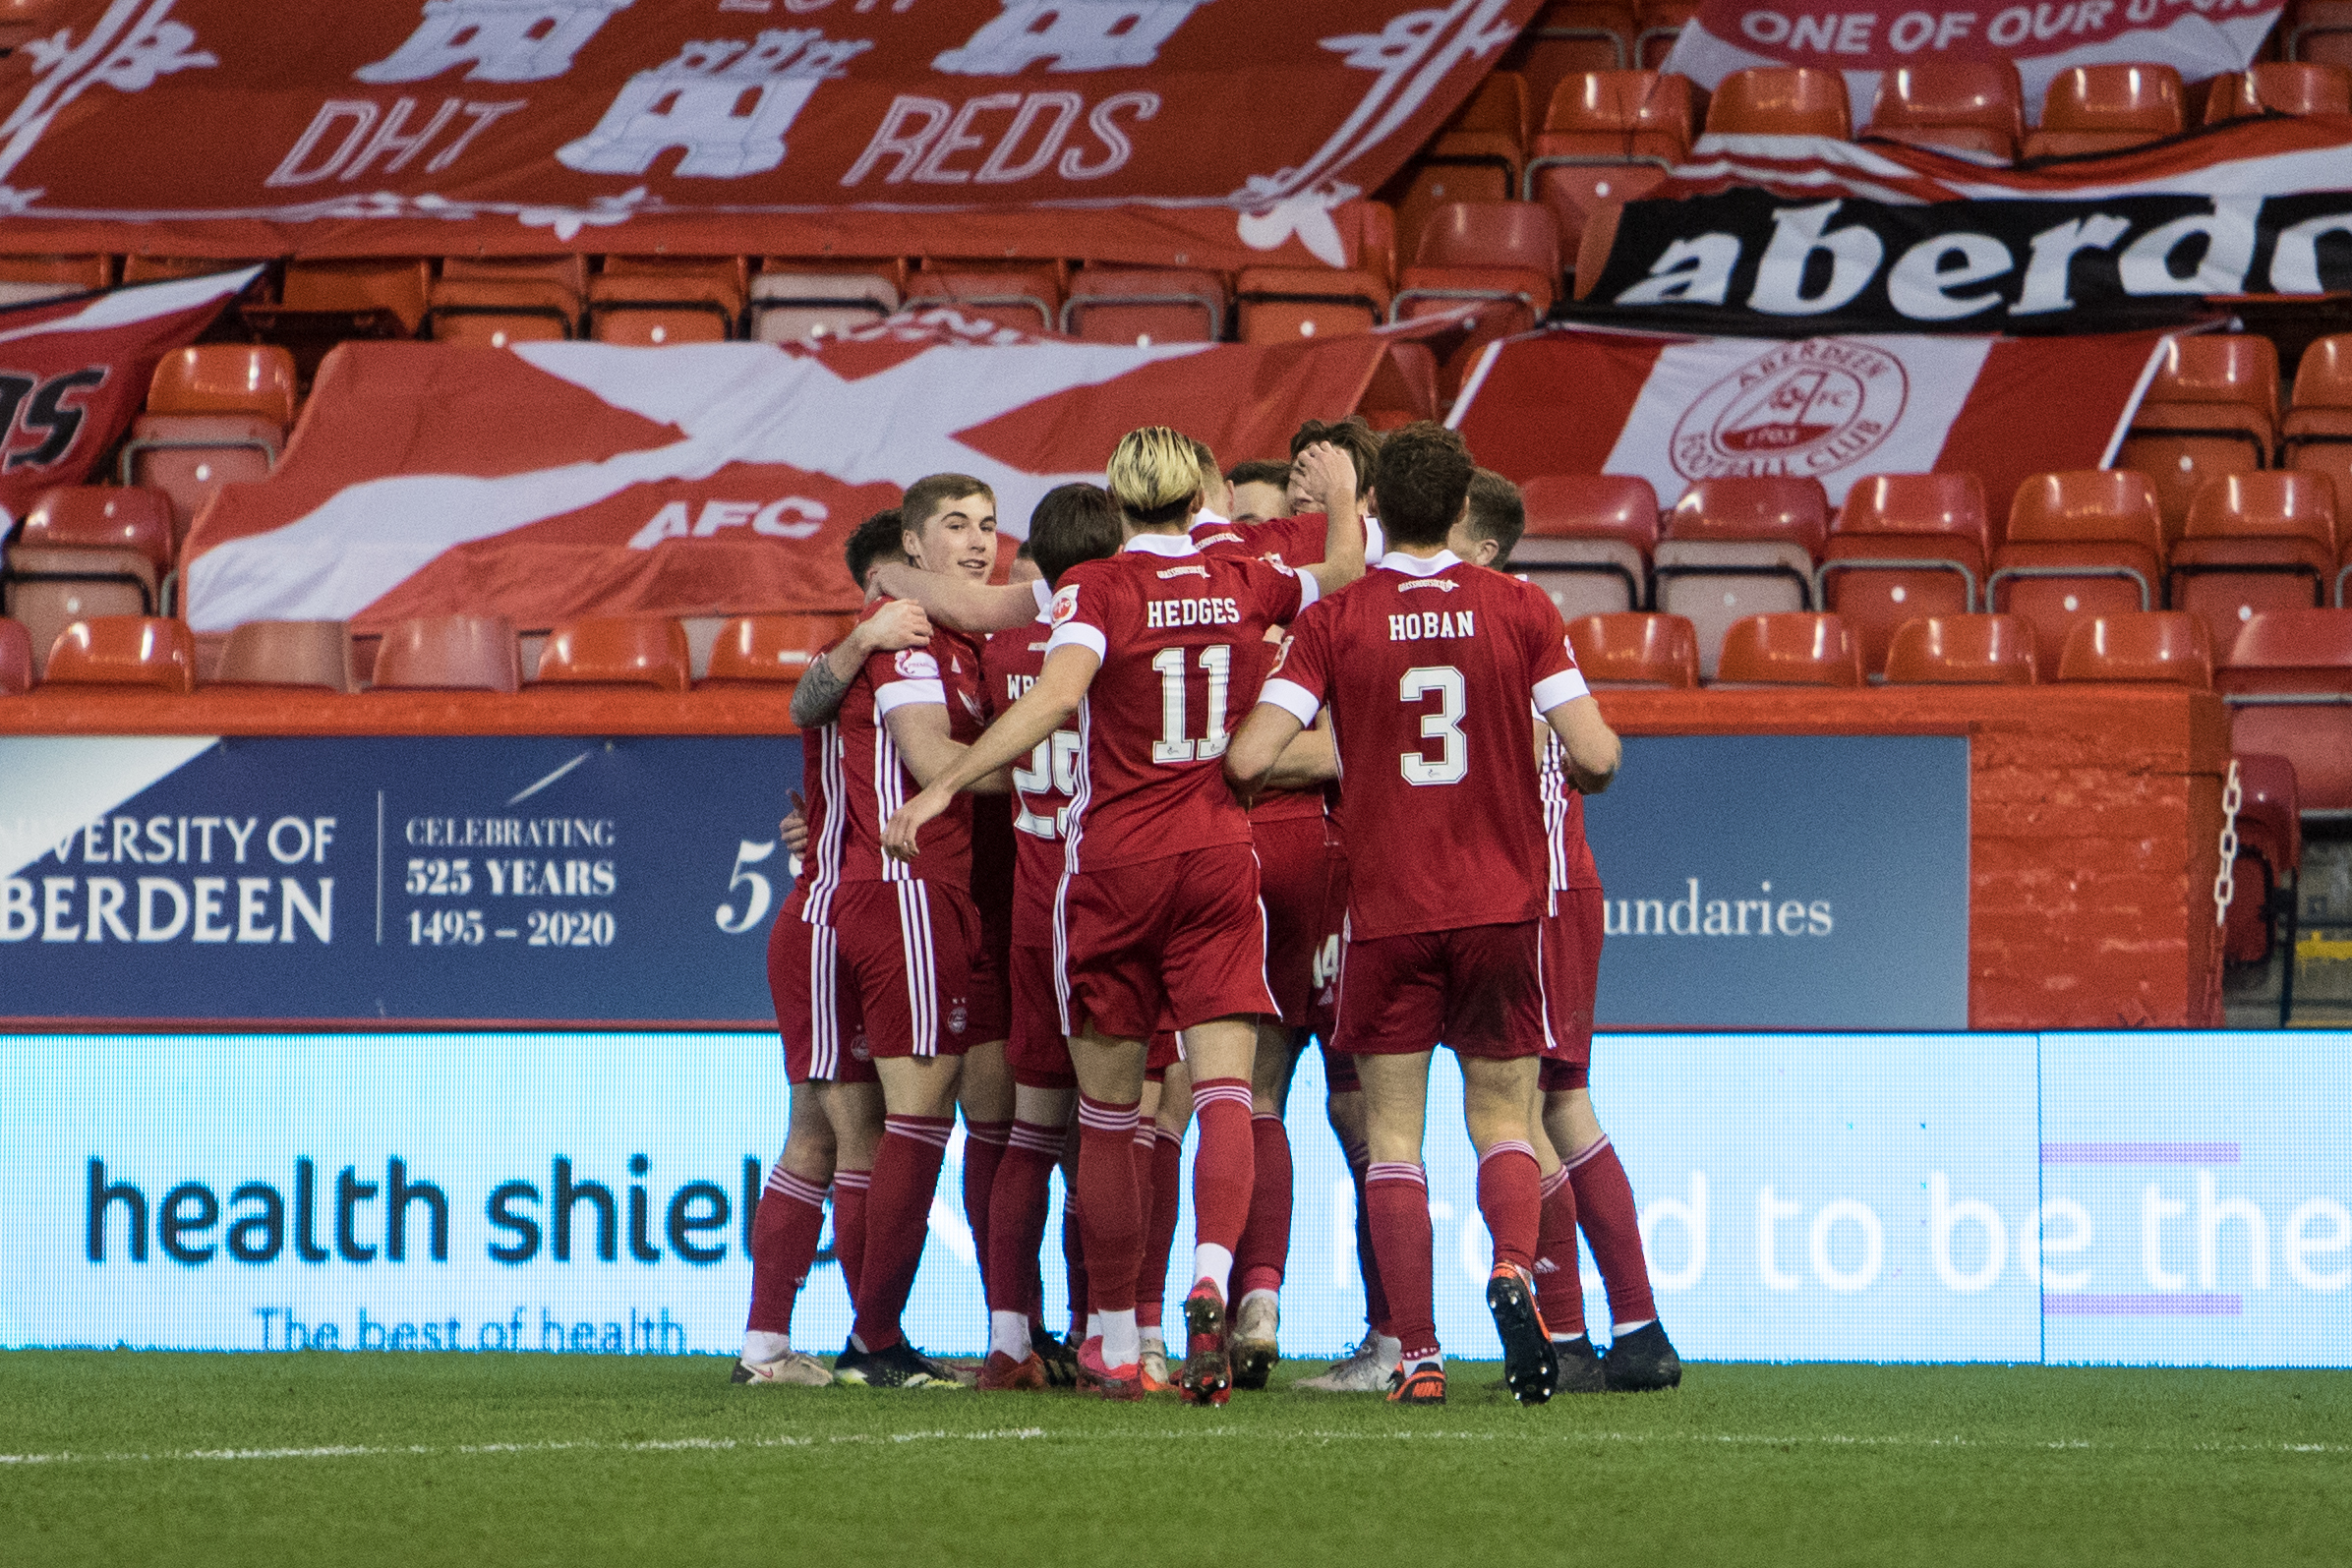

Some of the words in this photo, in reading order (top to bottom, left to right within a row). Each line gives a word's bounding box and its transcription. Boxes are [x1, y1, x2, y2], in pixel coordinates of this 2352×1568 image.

[1740, 10, 1876, 53] ONE
[1888, 11, 1976, 52] OF
[1986, 0, 2113, 47] OUR
[265, 97, 527, 187] DHT
[840, 90, 1160, 187] REDS
[627, 495, 830, 551] AFC
[1147, 598, 1240, 628] HEDGES
[1388, 610, 1475, 641] HOBAN
[1152, 645, 1230, 764] 11
[1399, 666, 1468, 786] 3
[267, 816, 336, 864] OF
[405, 817, 617, 847] CELEBRATING
[405, 858, 473, 896] 525
[486, 858, 617, 896] YEARS
[406, 909, 486, 946] 1495
[527, 909, 617, 946] 2020
[1604, 877, 1833, 936] undaries
[87, 1155, 449, 1264] health
[486, 1153, 836, 1265] shiel
[1757, 1185, 1883, 1291] to
[1930, 1171, 2092, 1291] be
[2142, 1169, 2352, 1291] the
[254, 1307, 339, 1352] The
[360, 1307, 461, 1353] best
[480, 1306, 526, 1354] of
[542, 1307, 686, 1355] health
